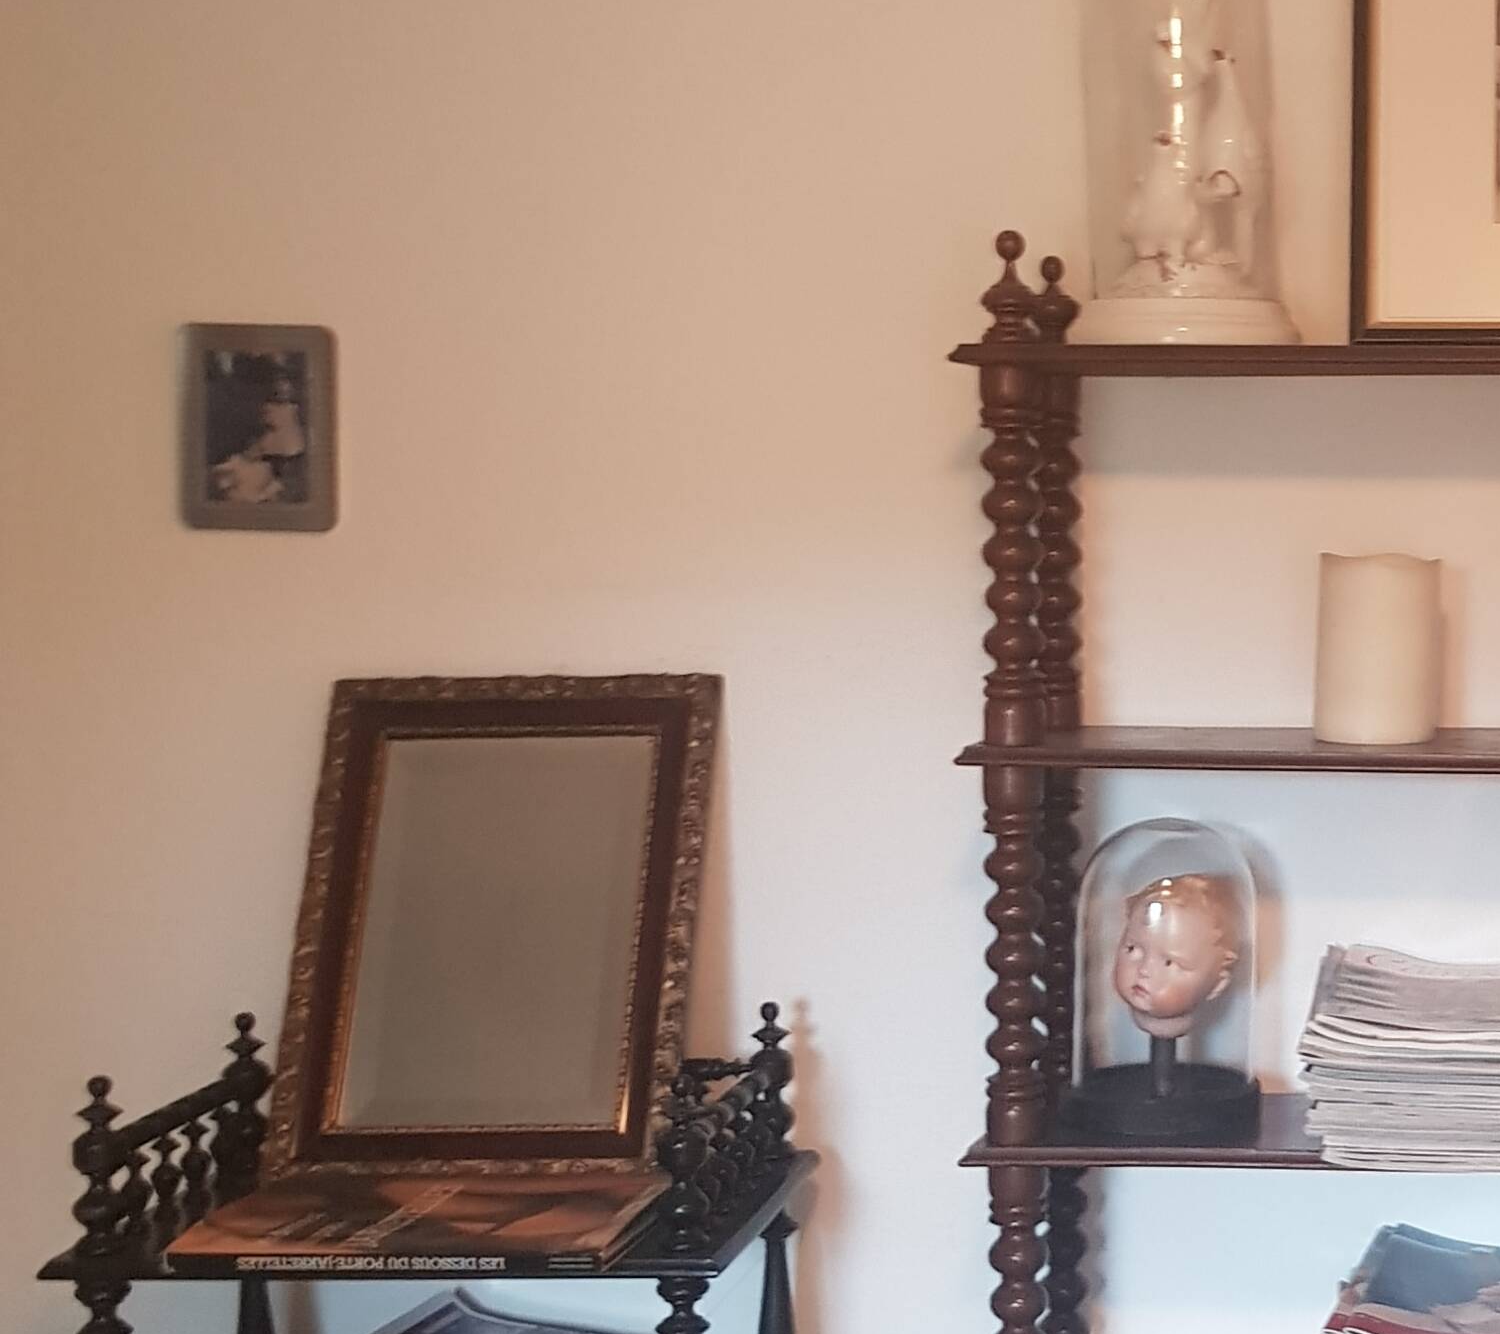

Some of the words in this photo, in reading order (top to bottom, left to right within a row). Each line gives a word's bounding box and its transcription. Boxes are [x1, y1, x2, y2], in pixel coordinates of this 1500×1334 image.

[387, 1256, 408, 1270] DU
[411, 1255, 477, 1270] DESSOUS
[479, 1256, 505, 1270] LES
